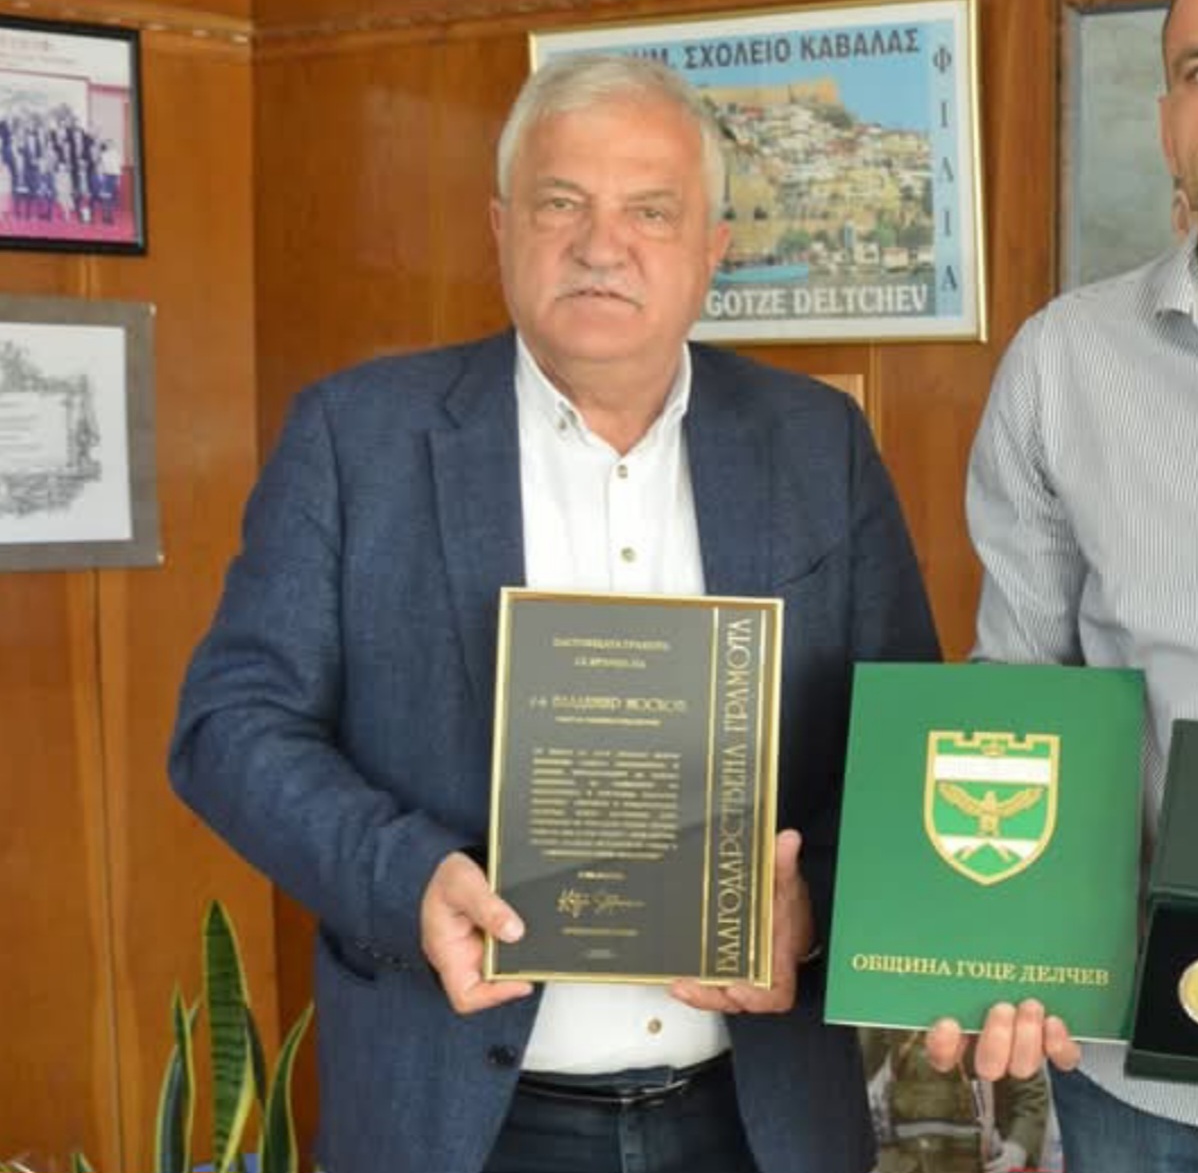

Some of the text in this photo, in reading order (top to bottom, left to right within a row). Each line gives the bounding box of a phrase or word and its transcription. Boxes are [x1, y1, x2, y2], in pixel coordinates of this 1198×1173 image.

[684, 38, 792, 70] ΣΧΟΛΕΙΟ
[800, 27, 920, 61] ΚΑΒΑΛΑΣ
[705, 284, 928, 317] GOTZE DELTCHEV
[852, 953, 1109, 985] ОБЩИНА ГОЦЕ ДЕЛЧЕВ
